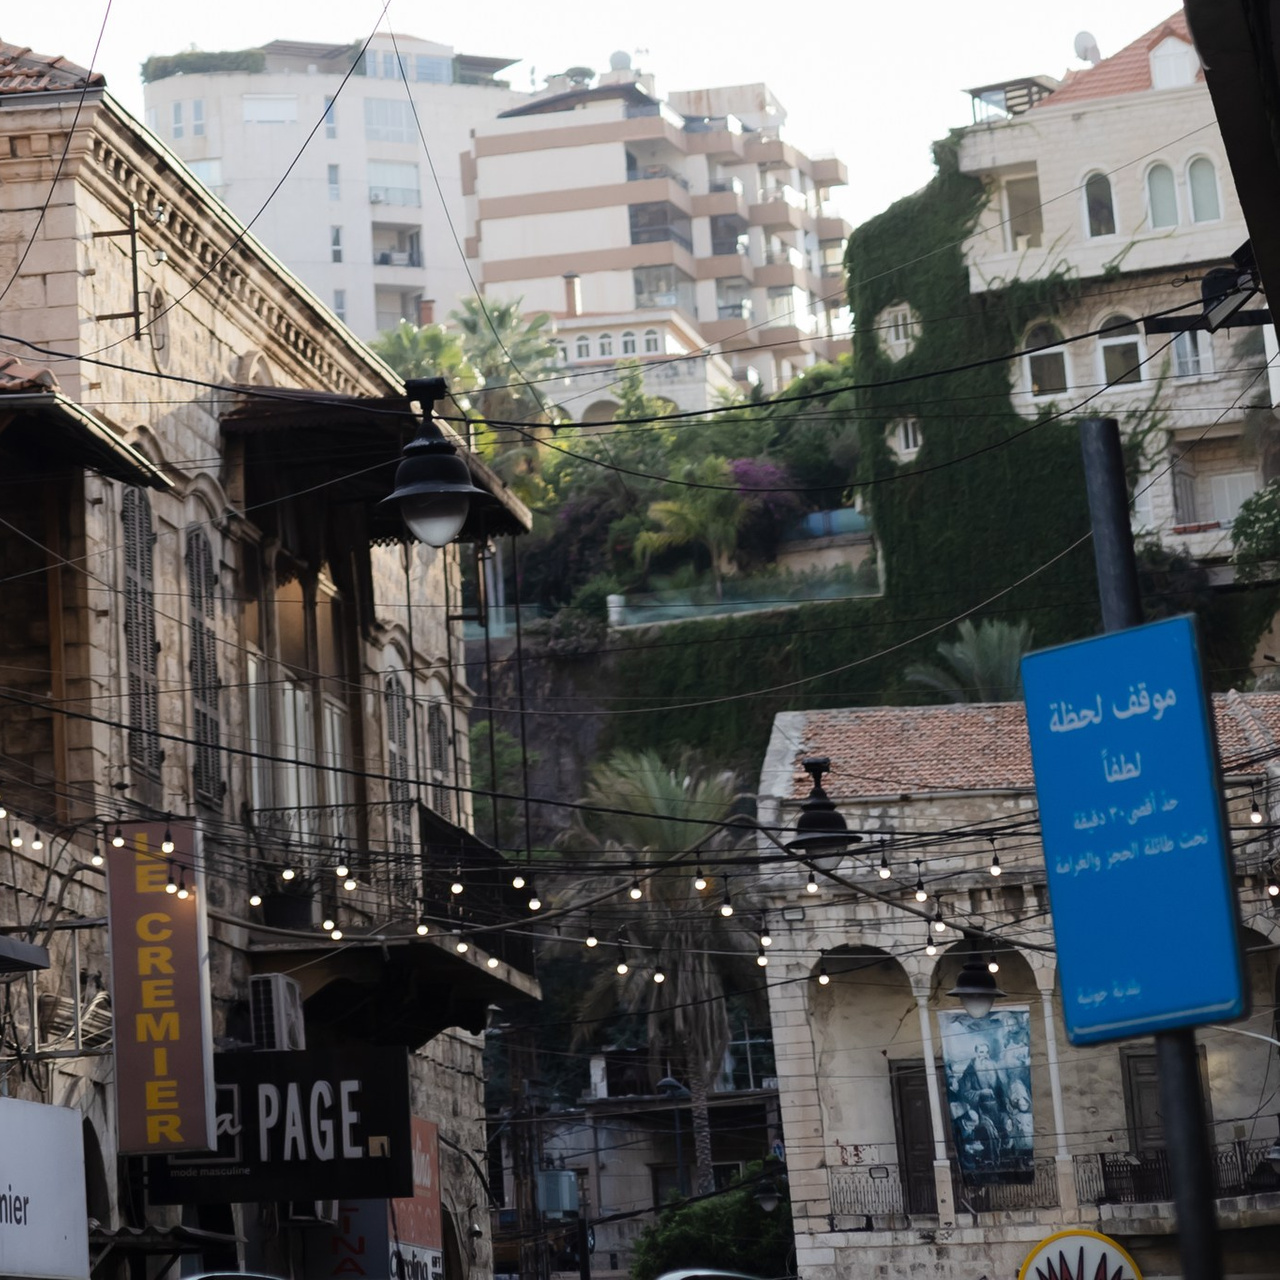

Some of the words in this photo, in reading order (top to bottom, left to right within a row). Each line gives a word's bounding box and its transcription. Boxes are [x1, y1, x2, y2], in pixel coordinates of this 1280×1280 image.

[1049, 694, 1103, 732] لحظة
[1112, 682, 1177, 720] موقف
[1074, 809, 1106, 834] دقيقة
[1179, 828, 1209, 849] تحت
[135, 832, 168, 893] LE
[135, 912, 185, 1143] CREMIER
[170, 1167, 198, 1177] mode
[199, 1166, 251, 1176] masculine
